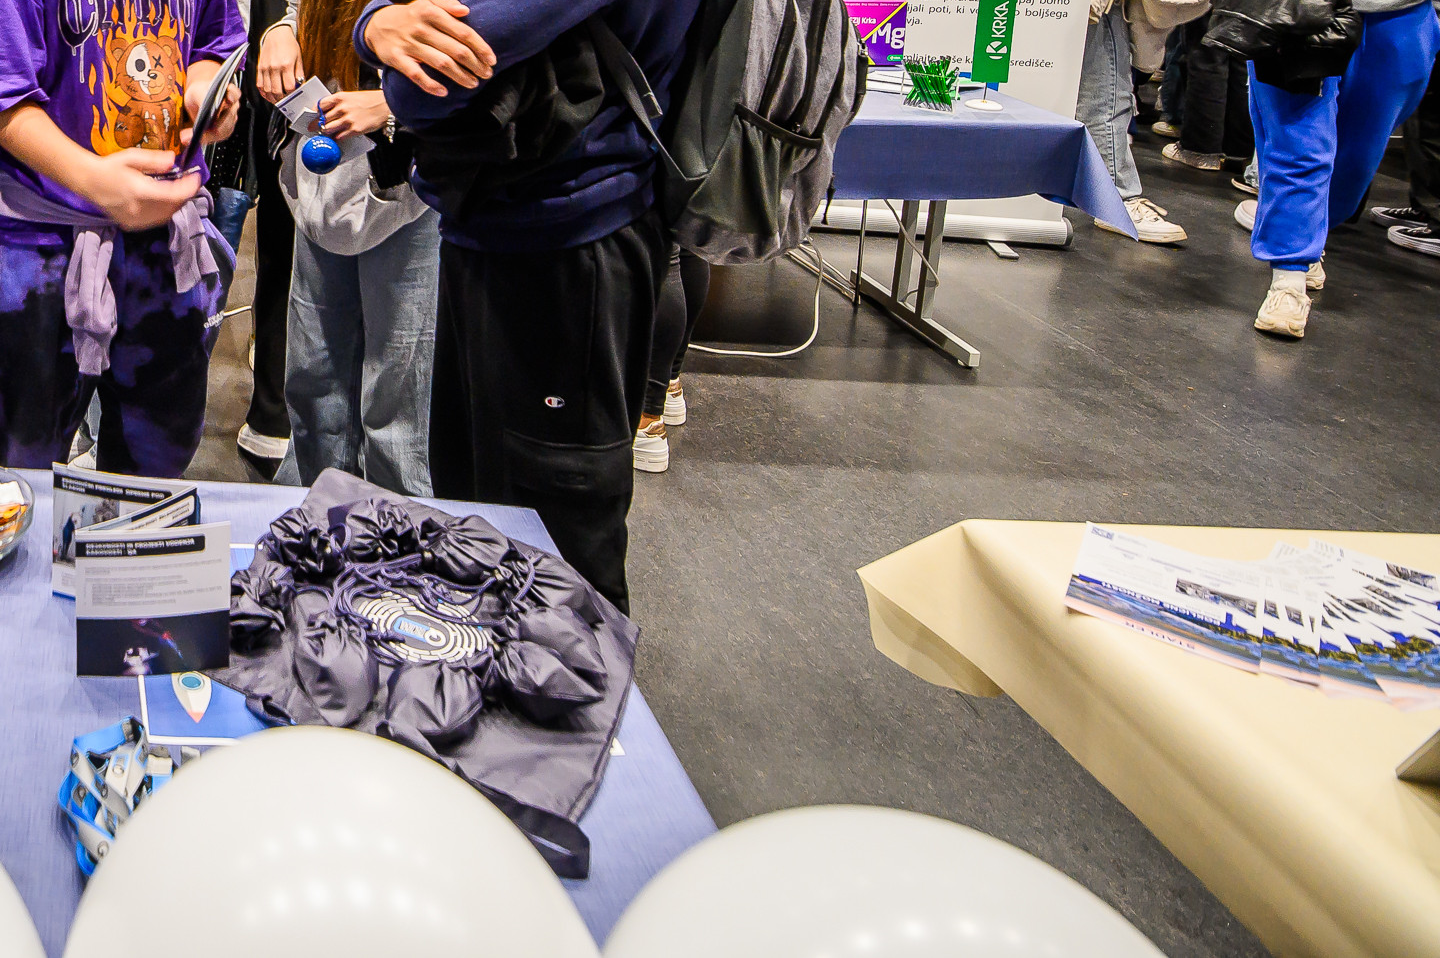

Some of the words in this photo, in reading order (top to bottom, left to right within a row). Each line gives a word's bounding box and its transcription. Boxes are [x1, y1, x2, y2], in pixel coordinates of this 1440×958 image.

[928, 5, 952, 15] poti,
[956, 5, 965, 14] ki
[1025, 7, 1068, 20] boljšega
[991, 0, 1010, 38] KRKA
[861, 17, 877, 25] Krka
[871, 23, 906, 50] Mg
[1010, 58, 1054, 69] središče:
